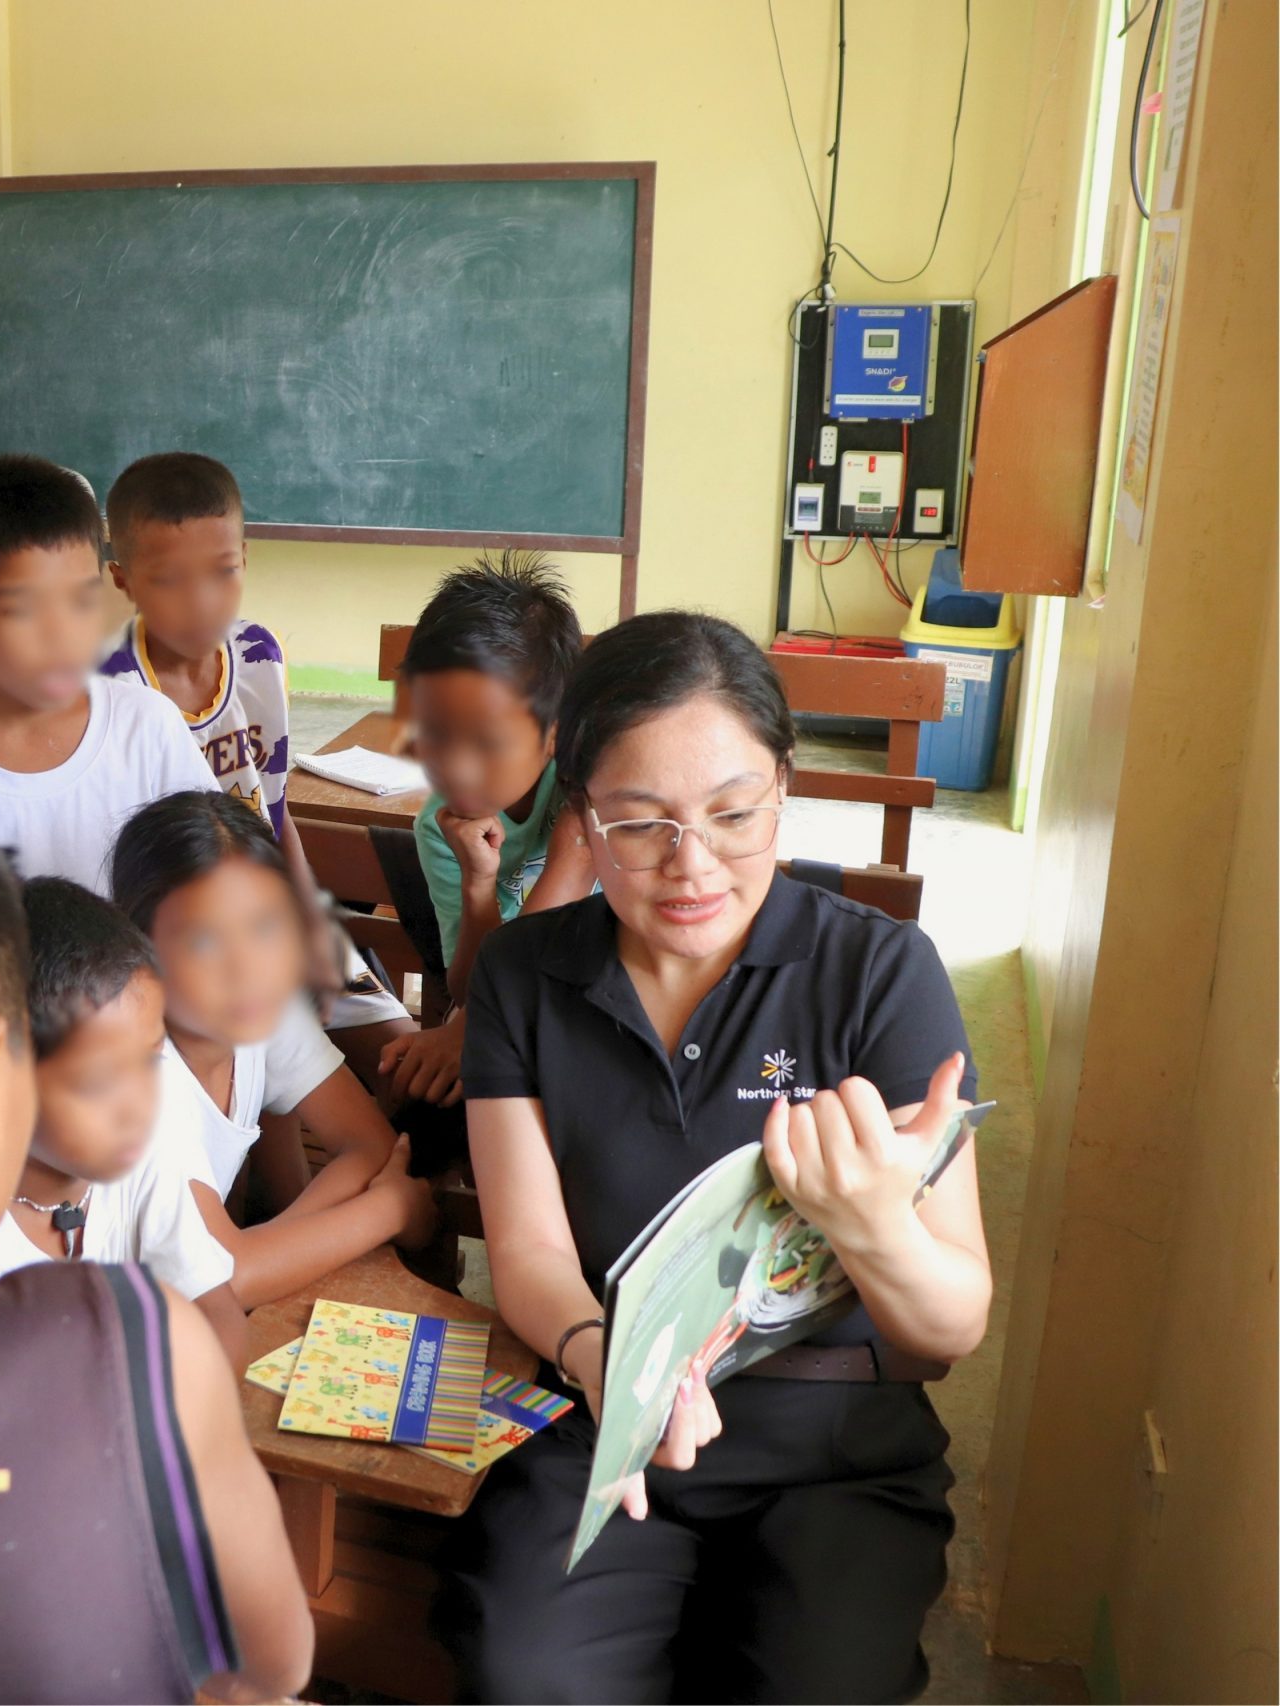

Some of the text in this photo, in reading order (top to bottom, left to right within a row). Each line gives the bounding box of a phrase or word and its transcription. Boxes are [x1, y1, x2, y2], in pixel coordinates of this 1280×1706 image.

[200, 725, 268, 778] ERS
[737, 1086, 817, 1100] Northern Star
